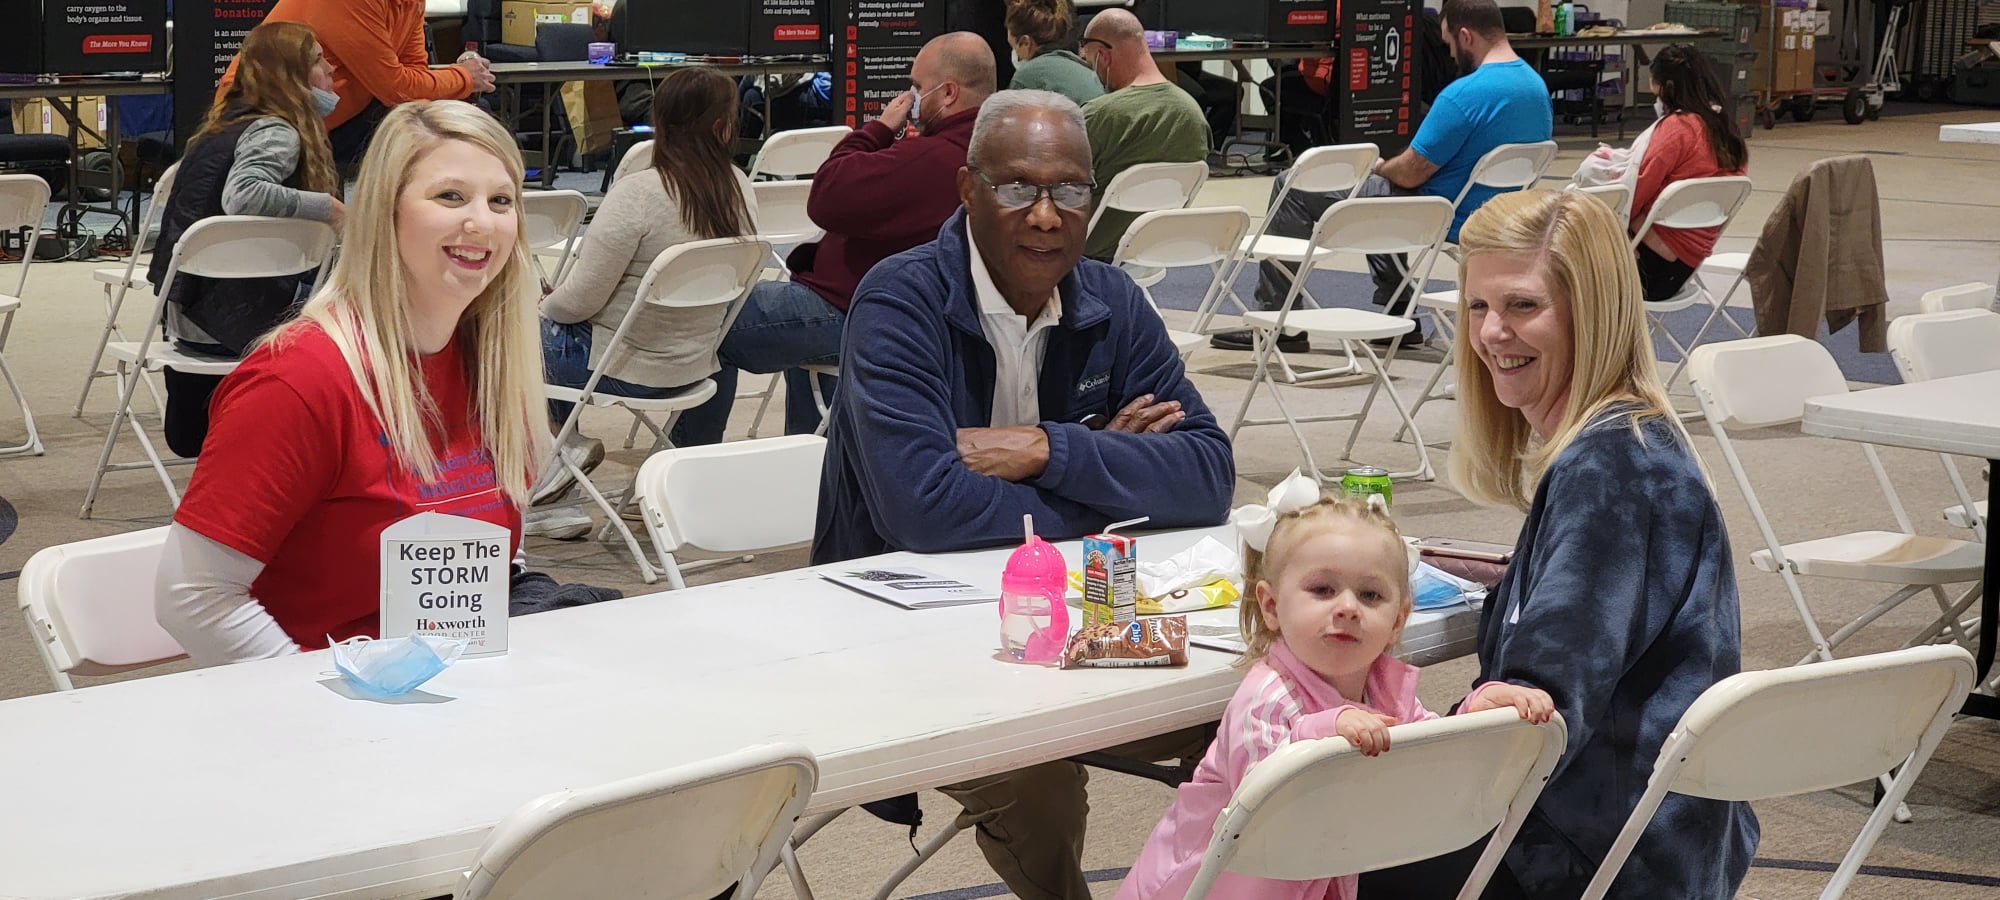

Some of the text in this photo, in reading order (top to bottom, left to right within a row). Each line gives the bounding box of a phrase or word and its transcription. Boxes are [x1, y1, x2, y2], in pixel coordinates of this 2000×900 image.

[67, 16, 87, 24] body's
[88, 16, 109, 24] organs
[214, 9, 264, 18] Donation
[864, 102, 879, 110] YOU
[468, 472, 494, 489] Cen
[400, 541, 500, 566] Keep The
[411, 566, 489, 585] STORM
[418, 592, 483, 612] Going
[416, 616, 486, 630] Hoxworth
[1130, 620, 1142, 643] Chip
